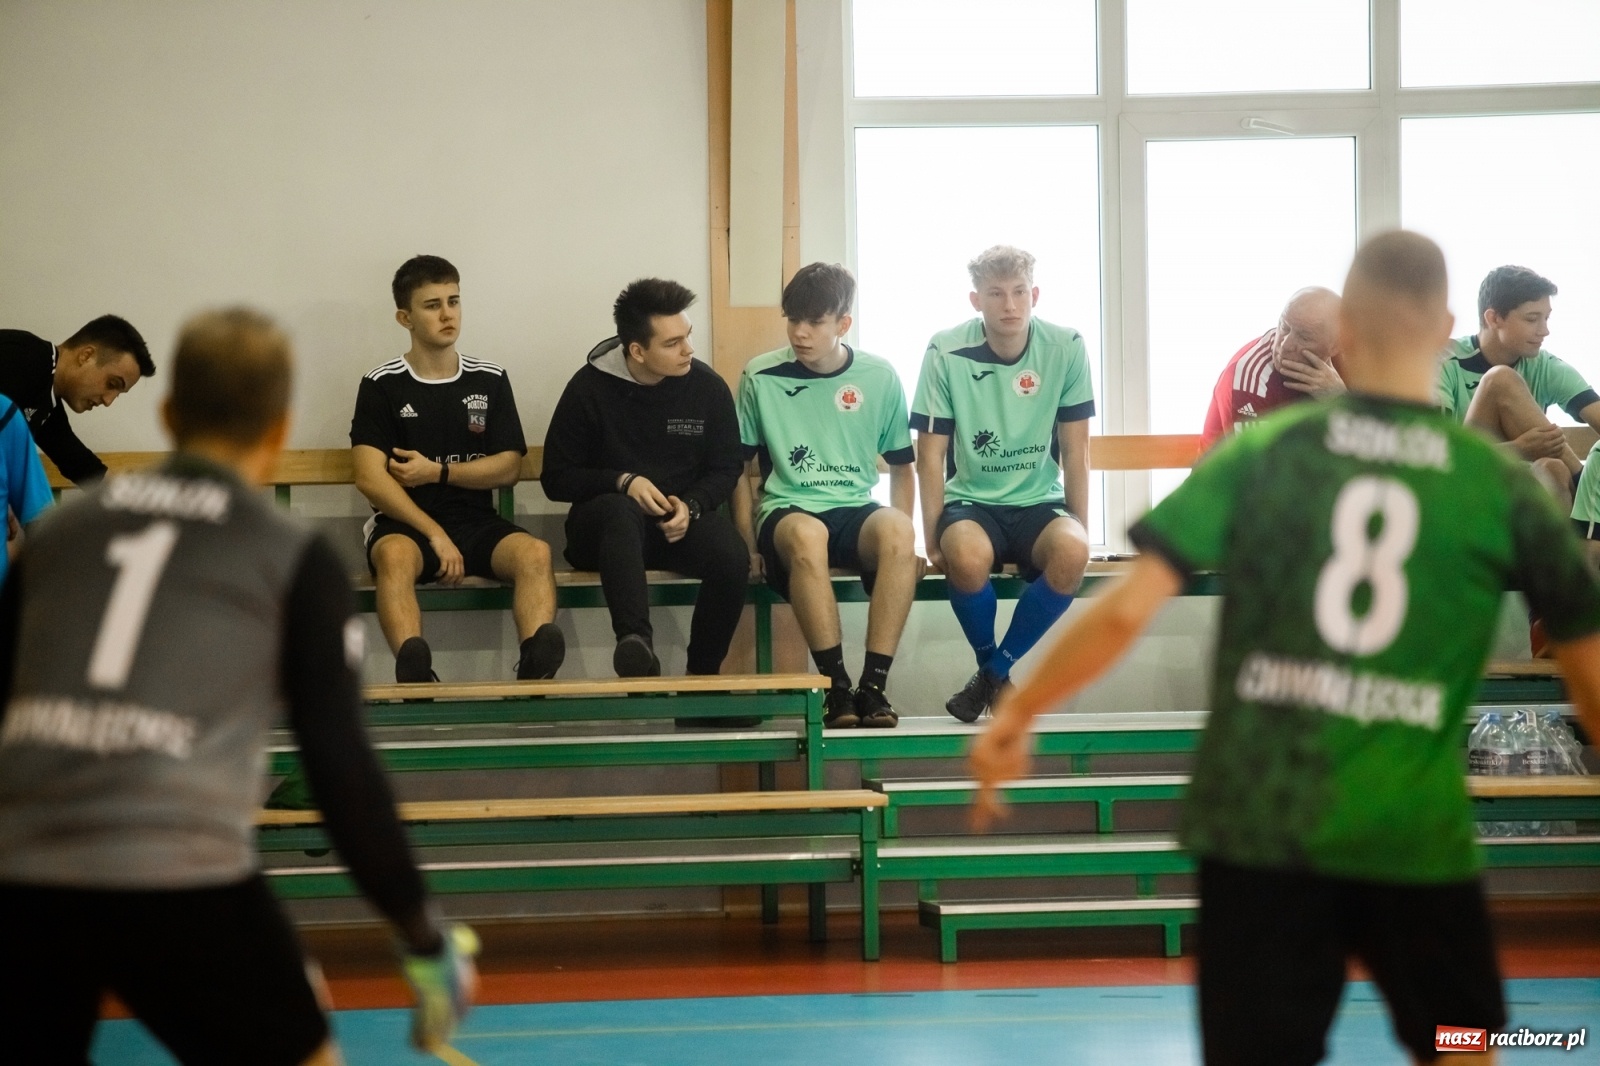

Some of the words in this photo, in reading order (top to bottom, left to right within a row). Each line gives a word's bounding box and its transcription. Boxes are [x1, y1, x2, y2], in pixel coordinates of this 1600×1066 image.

[470, 415, 486, 426] KS
[1000, 444, 1046, 458] Jureczka
[816, 463, 861, 473] Jureczka
[1314, 473, 1420, 656] 8
[88, 519, 179, 689] 1
